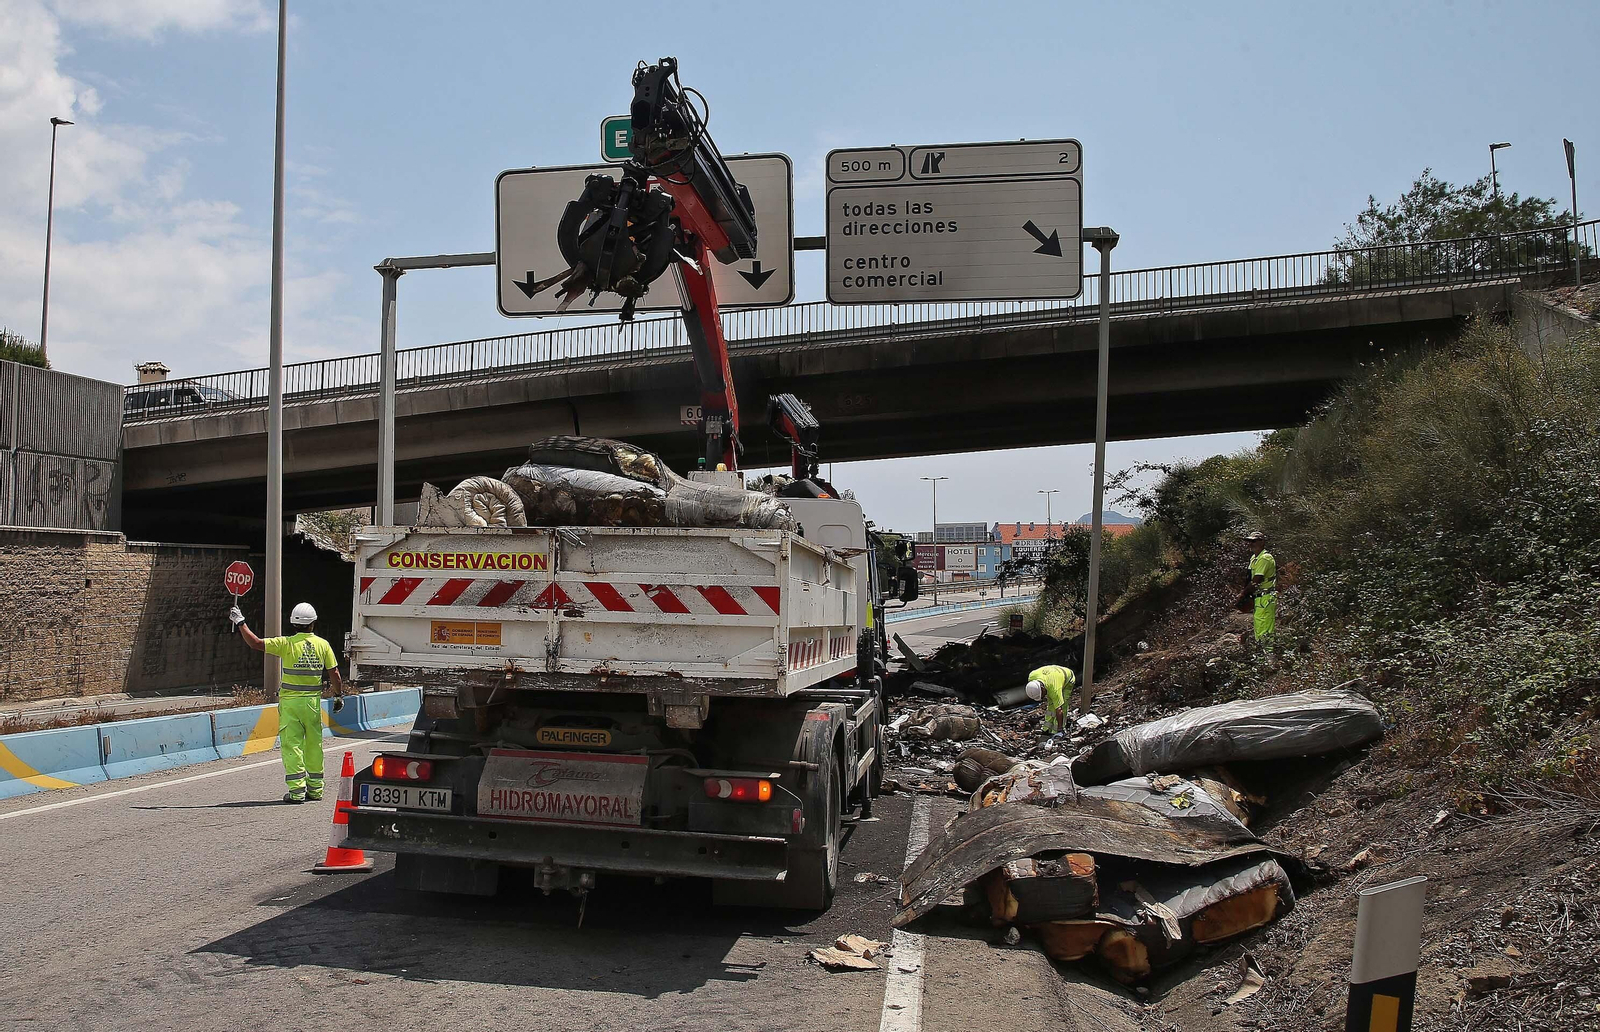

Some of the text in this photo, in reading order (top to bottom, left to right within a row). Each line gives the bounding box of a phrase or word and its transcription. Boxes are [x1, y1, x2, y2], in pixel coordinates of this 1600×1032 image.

[841, 160, 891, 172] 500 m
[1058, 152, 1068, 164] 2
[842, 200, 934, 217] todas las
[842, 219, 958, 237] direcciones
[843, 254, 911, 270] centro
[842, 270, 943, 288] comercial
[388, 551, 548, 570] CONSERVACION
[227, 571, 251, 586] STOP
[541, 730, 607, 744] PALFINGER
[373, 787, 447, 809] 8391 KTM
[490, 788, 635, 819] HIDROMAYORAL
